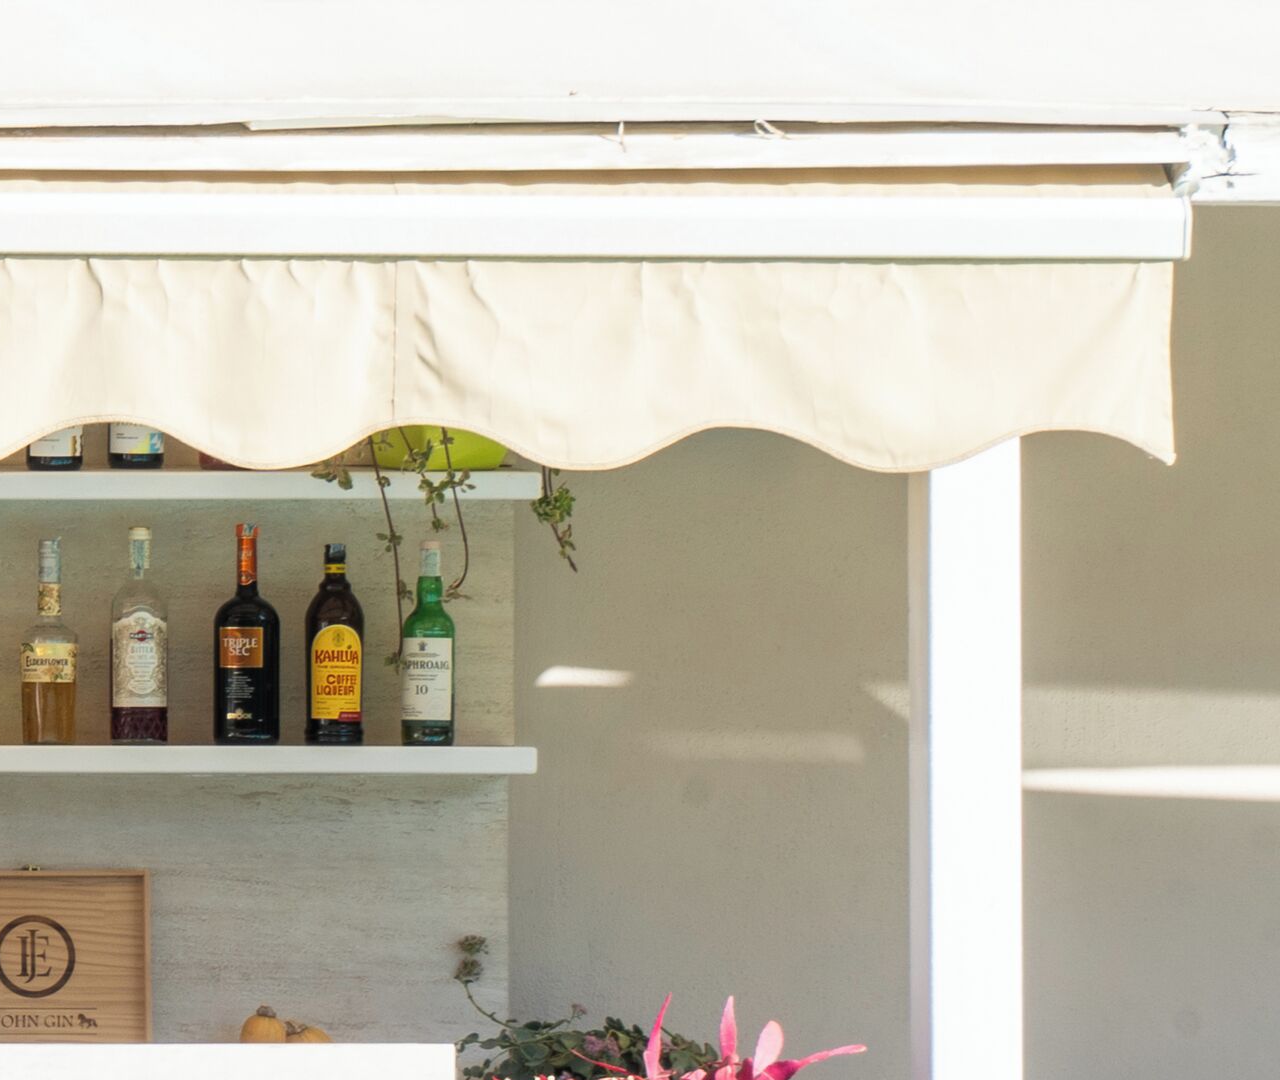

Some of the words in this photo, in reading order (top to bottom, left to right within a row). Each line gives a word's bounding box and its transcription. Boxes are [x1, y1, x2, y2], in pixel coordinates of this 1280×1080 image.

[222, 638, 258, 648] TRIPLE
[228, 646, 250, 656] SEC
[314, 644, 359, 664] KAHLÚA
[326, 674, 357, 685] COFFEE
[315, 685, 355, 696] LIQUEUR
[415, 684, 429, 696] 10
[44, 1014, 74, 1028] GIN
